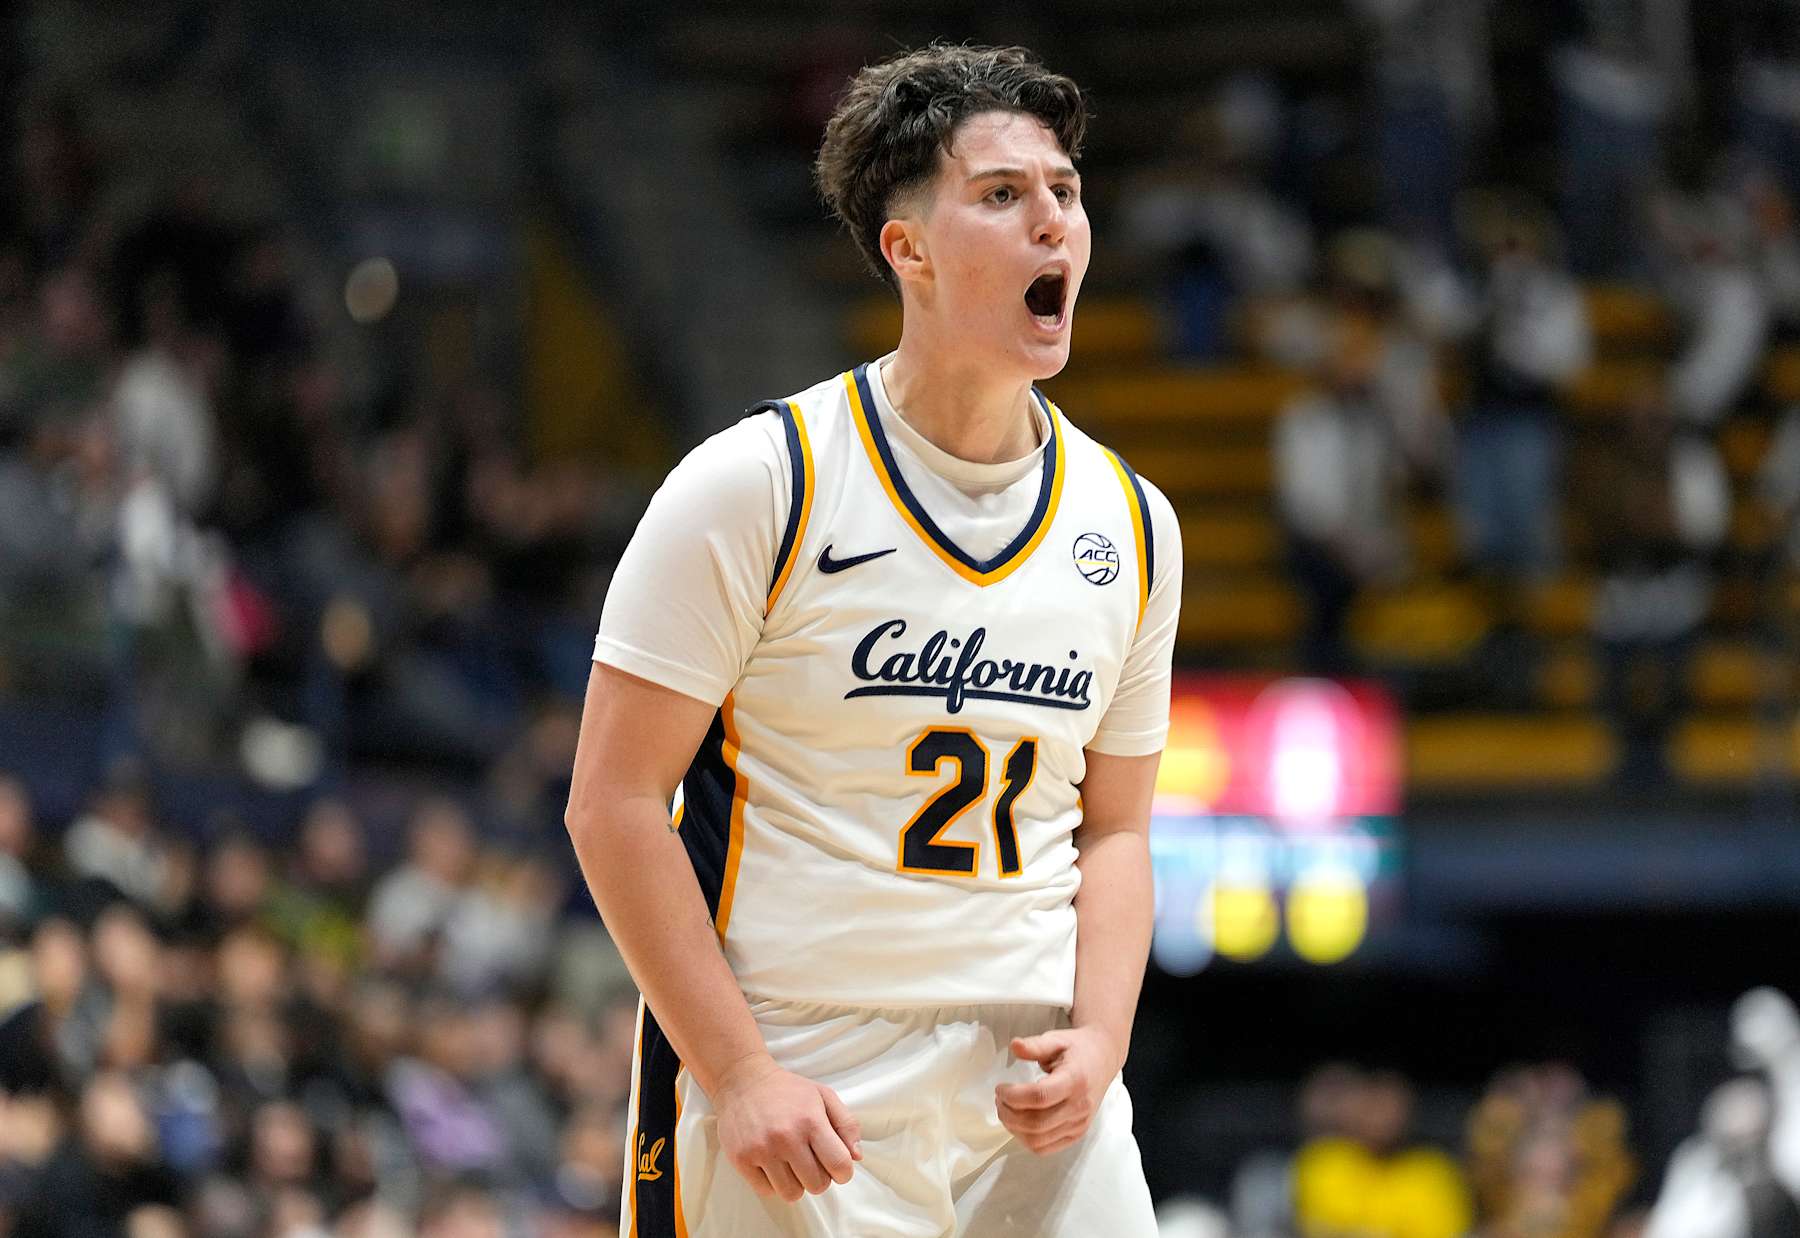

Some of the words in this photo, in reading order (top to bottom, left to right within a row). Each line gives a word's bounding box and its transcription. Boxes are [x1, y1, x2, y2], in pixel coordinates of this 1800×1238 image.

[1079, 549, 1117, 563] ACC
[850, 619, 1093, 714] California
[896, 725, 1039, 879] 21
